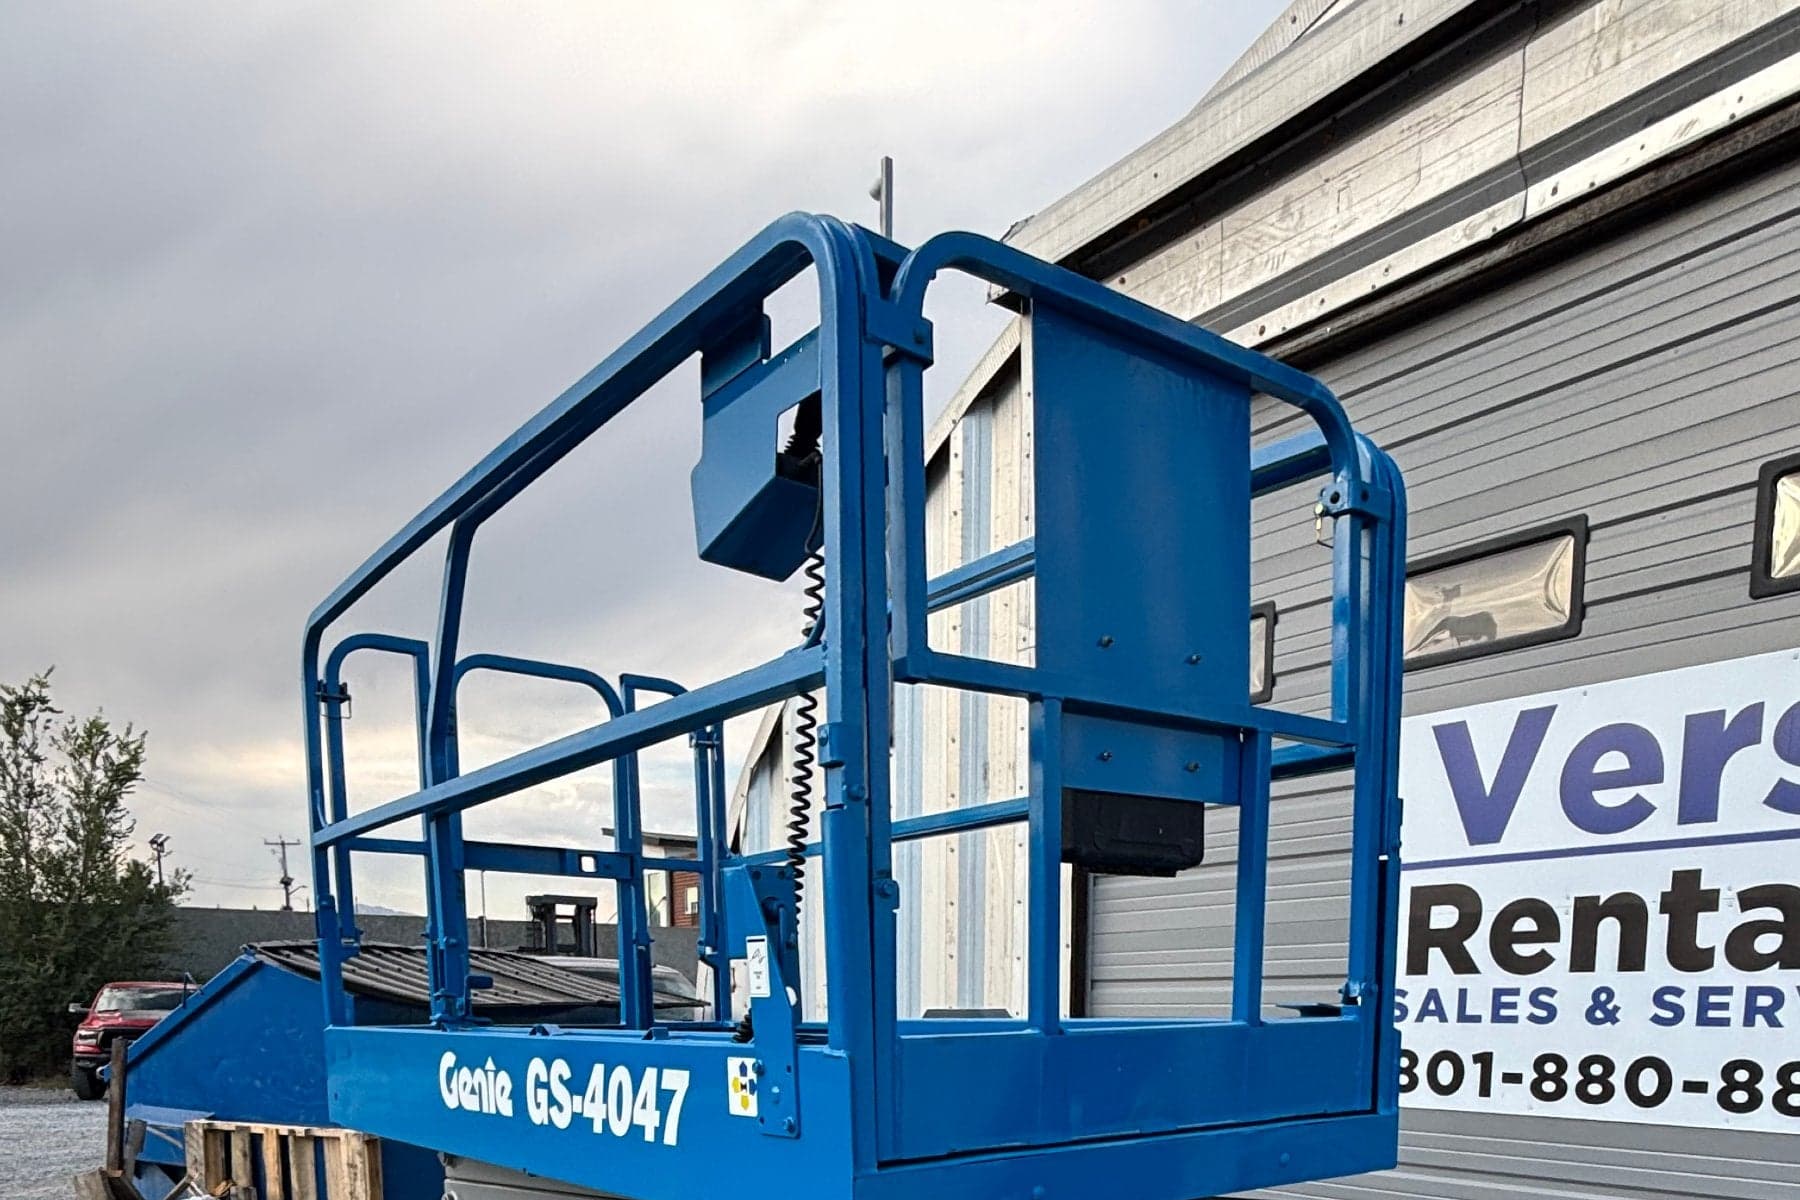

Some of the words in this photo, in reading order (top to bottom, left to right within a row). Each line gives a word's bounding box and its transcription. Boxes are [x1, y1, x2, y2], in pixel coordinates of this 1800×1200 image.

[1405, 868, 1800, 976] Renta
[1584, 986, 1621, 1026] &
[1650, 985, 1800, 1028] SER
[439, 1051, 513, 1117] Genie
[526, 1057, 690, 1146] GS-4047
